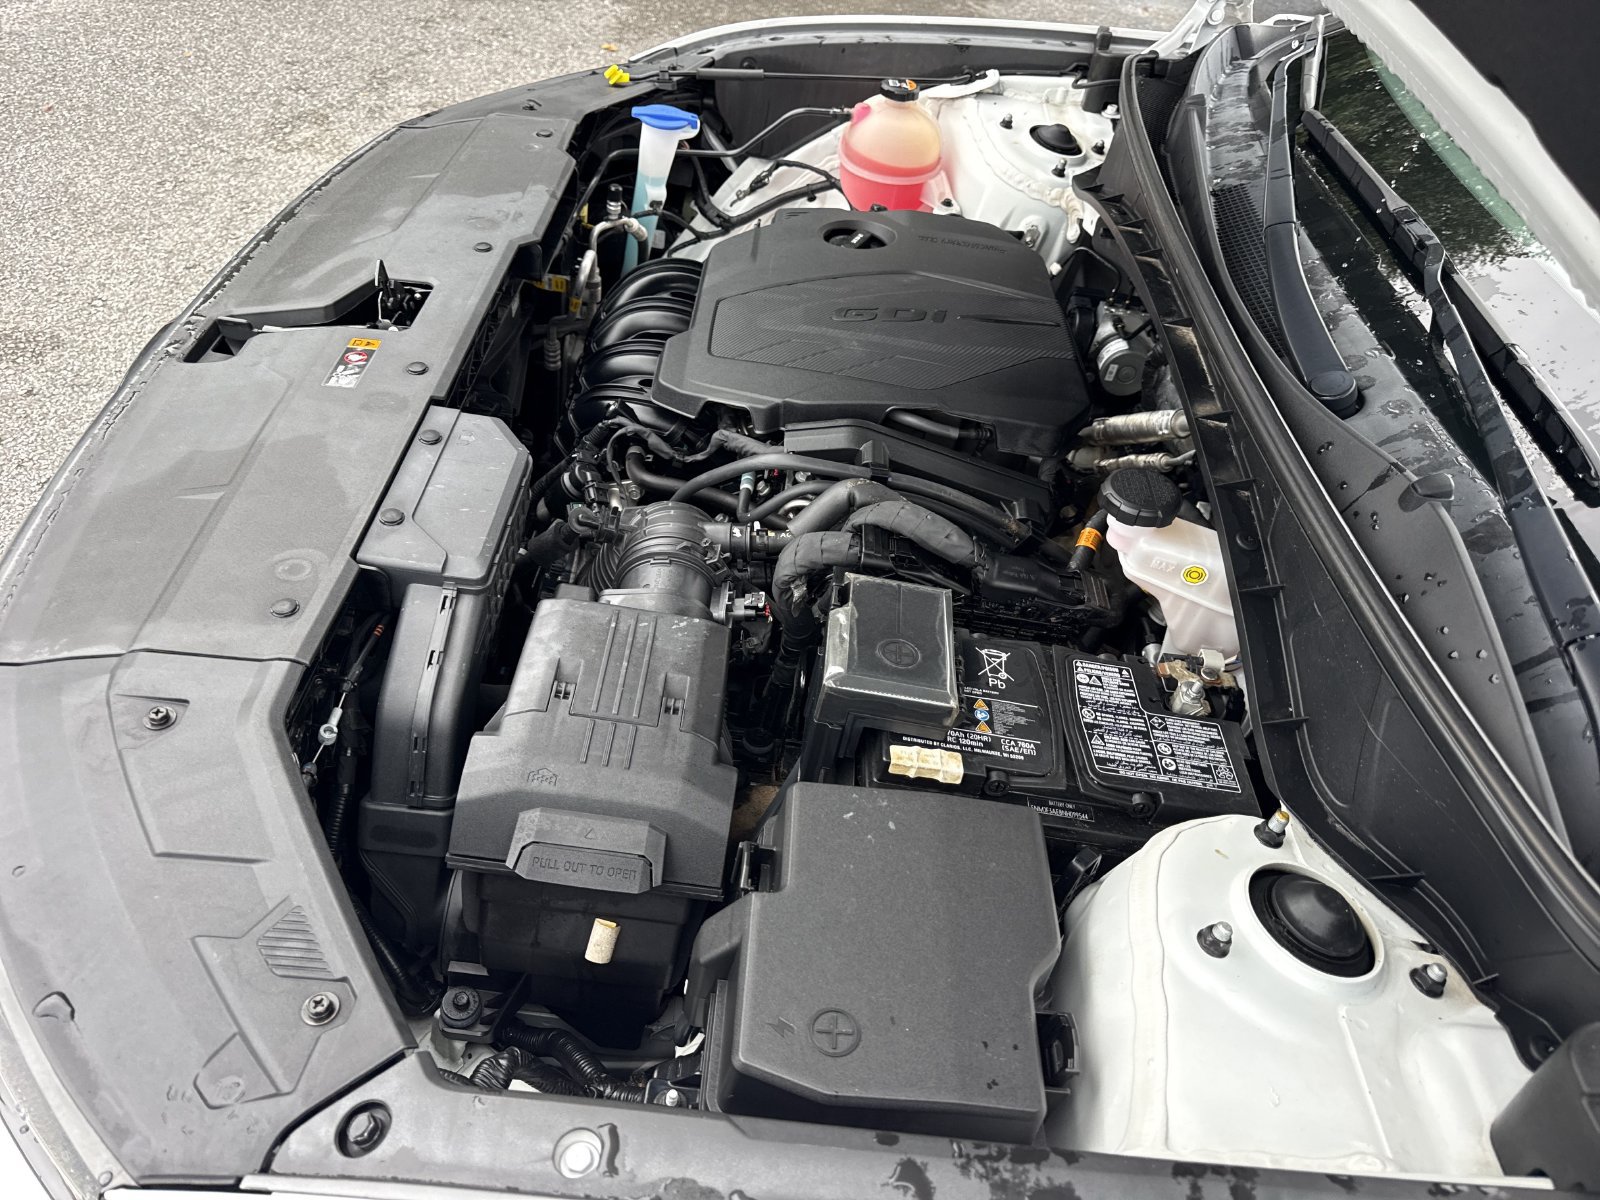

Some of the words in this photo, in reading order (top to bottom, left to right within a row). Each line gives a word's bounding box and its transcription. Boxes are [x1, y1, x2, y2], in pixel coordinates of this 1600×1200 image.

[1150, 557, 1177, 573] MAX
[988, 677, 1006, 690] Pb
[902, 736, 933, 745] DISTRIBUTED
[946, 735, 957, 743] RC
[958, 737, 984, 748] 120min
[966, 732, 992, 743] (20HR)
[1000, 738, 1016, 747] CCA
[1017, 741, 1036, 750] 780A
[532, 856, 559, 870] PULL
[562, 861, 587, 873] OUT
[589, 864, 604, 876] TO
[606, 868, 638, 881] OPEN
